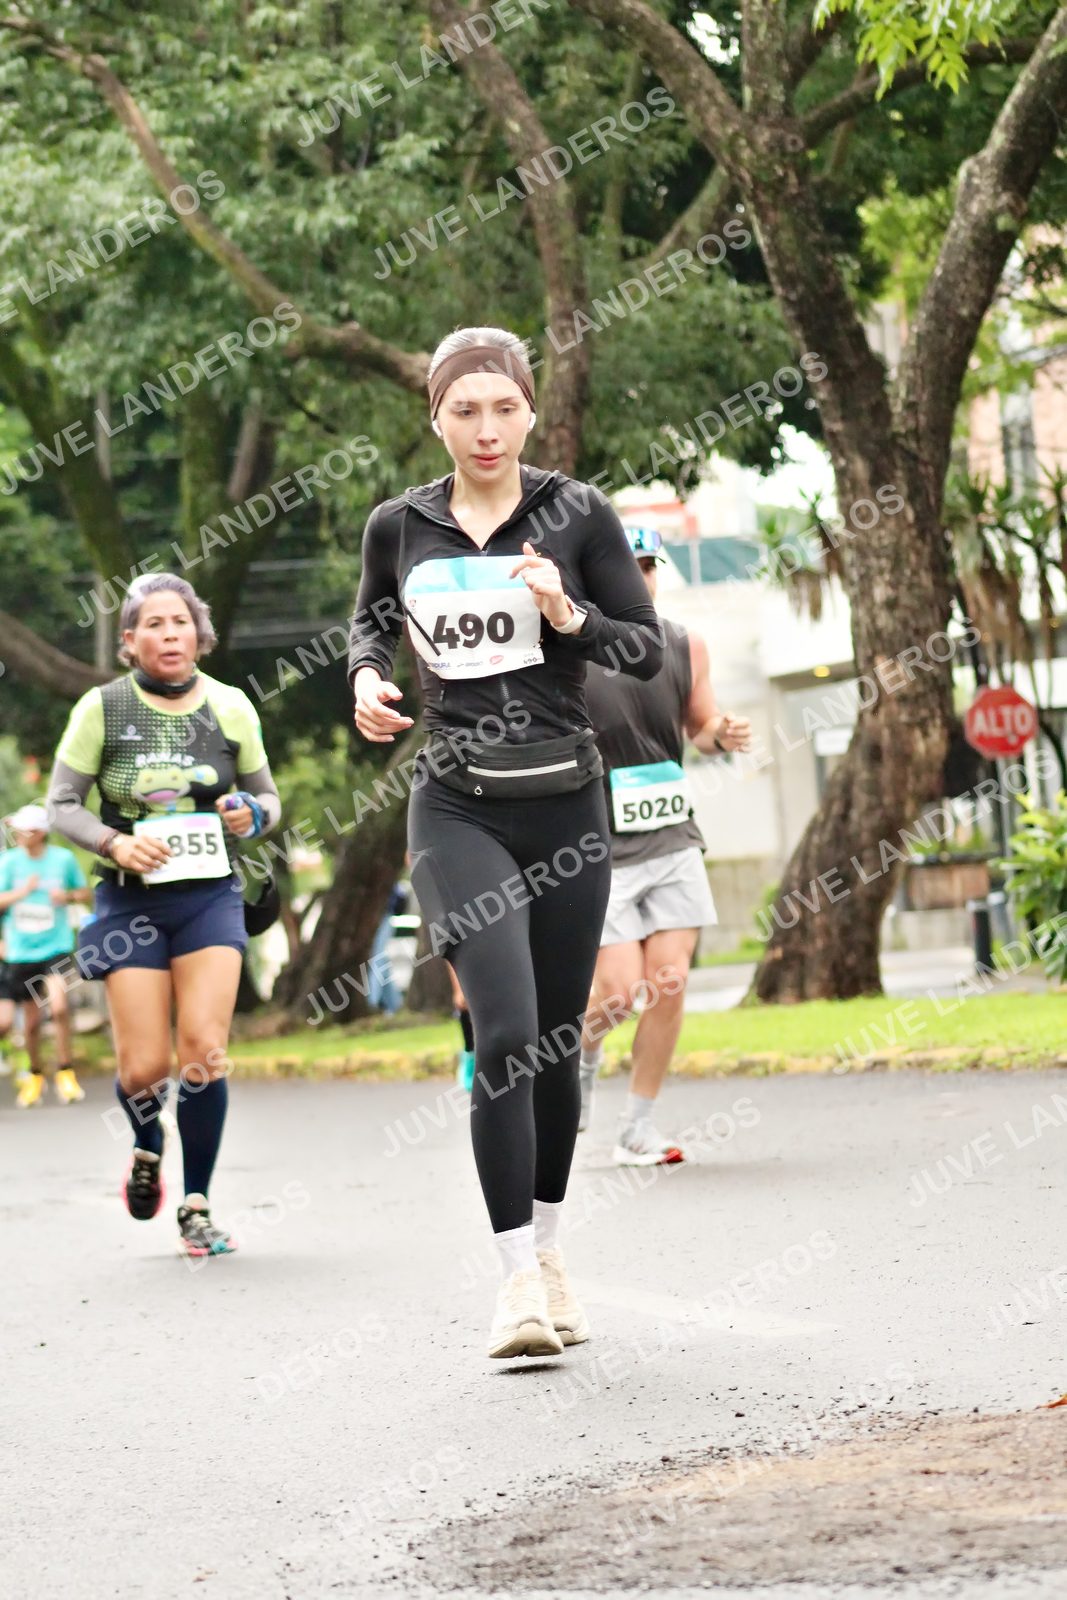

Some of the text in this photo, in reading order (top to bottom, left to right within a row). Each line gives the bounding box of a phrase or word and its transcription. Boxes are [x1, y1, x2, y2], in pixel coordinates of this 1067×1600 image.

[433, 611, 515, 650] 490
[973, 704, 1034, 737] ALTO
[622, 794, 684, 823] 5020
[155, 832, 218, 858] 855
